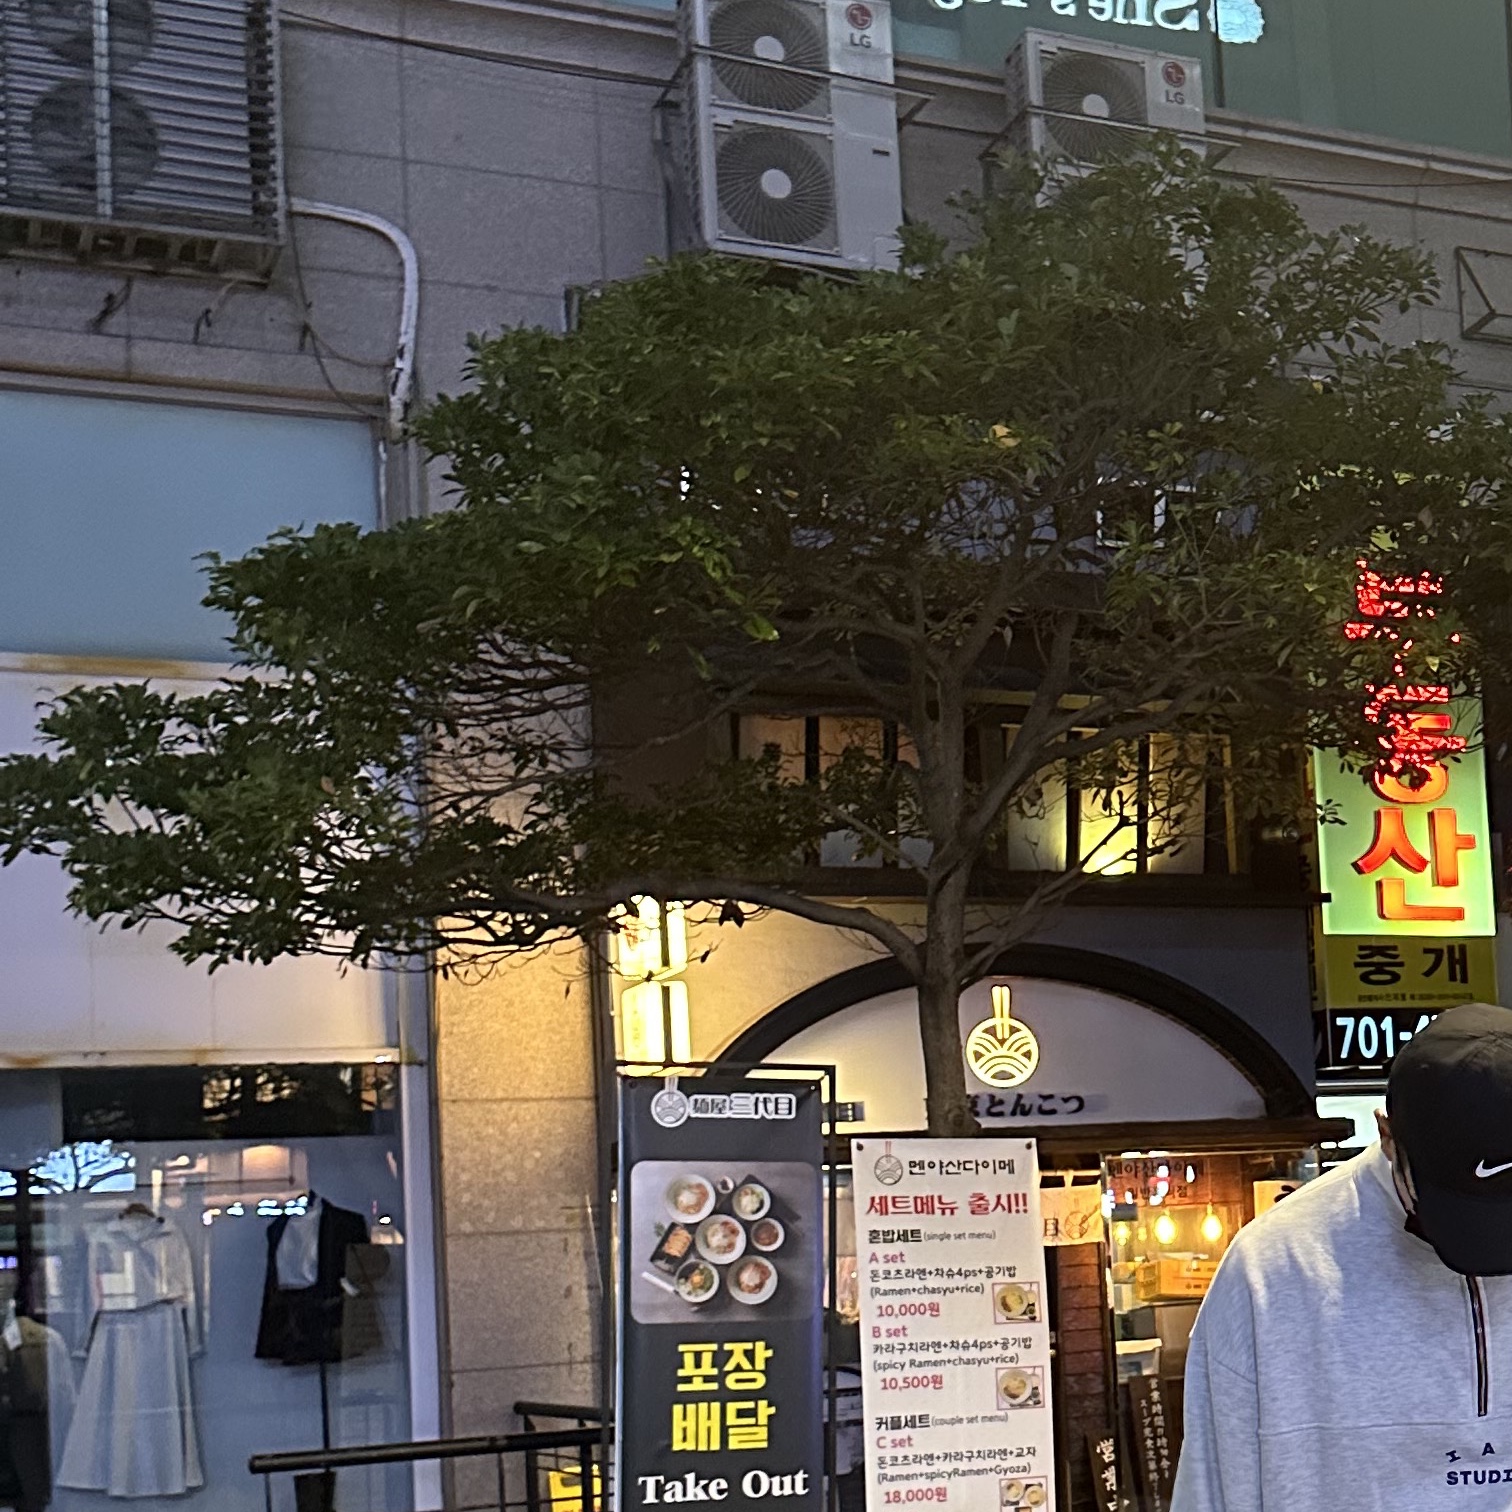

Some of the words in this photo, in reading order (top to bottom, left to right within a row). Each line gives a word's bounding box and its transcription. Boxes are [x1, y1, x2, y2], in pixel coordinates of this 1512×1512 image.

[850, 33, 873, 48] LG
[1165, 89, 1185, 105] LG
[1353, 943, 1469, 986] 중개
[908, 1159, 1016, 1176] 멘야산다이메
[865, 1194, 960, 1217] 세트메뉴
[968, 1192, 1029, 1216] 출시!!
[869, 1252, 879, 1263] A
[883, 1251, 906, 1263] set
[877, 1302, 941, 1318] 10,000원
[872, 1326, 881, 1338] B
[886, 1325, 909, 1338] set
[676, 1340, 774, 1392] 포장
[873, 1359, 906, 1373] (spicy
[881, 1374, 944, 1390] 10,500원
[671, 1399, 777, 1452] 배달
[876, 1436, 887, 1449] C
[890, 1435, 914, 1448] set
[637, 1471, 729, 1504] Take
[741, 1468, 810, 1499] Out
[884, 1487, 948, 1504] 18,000원
